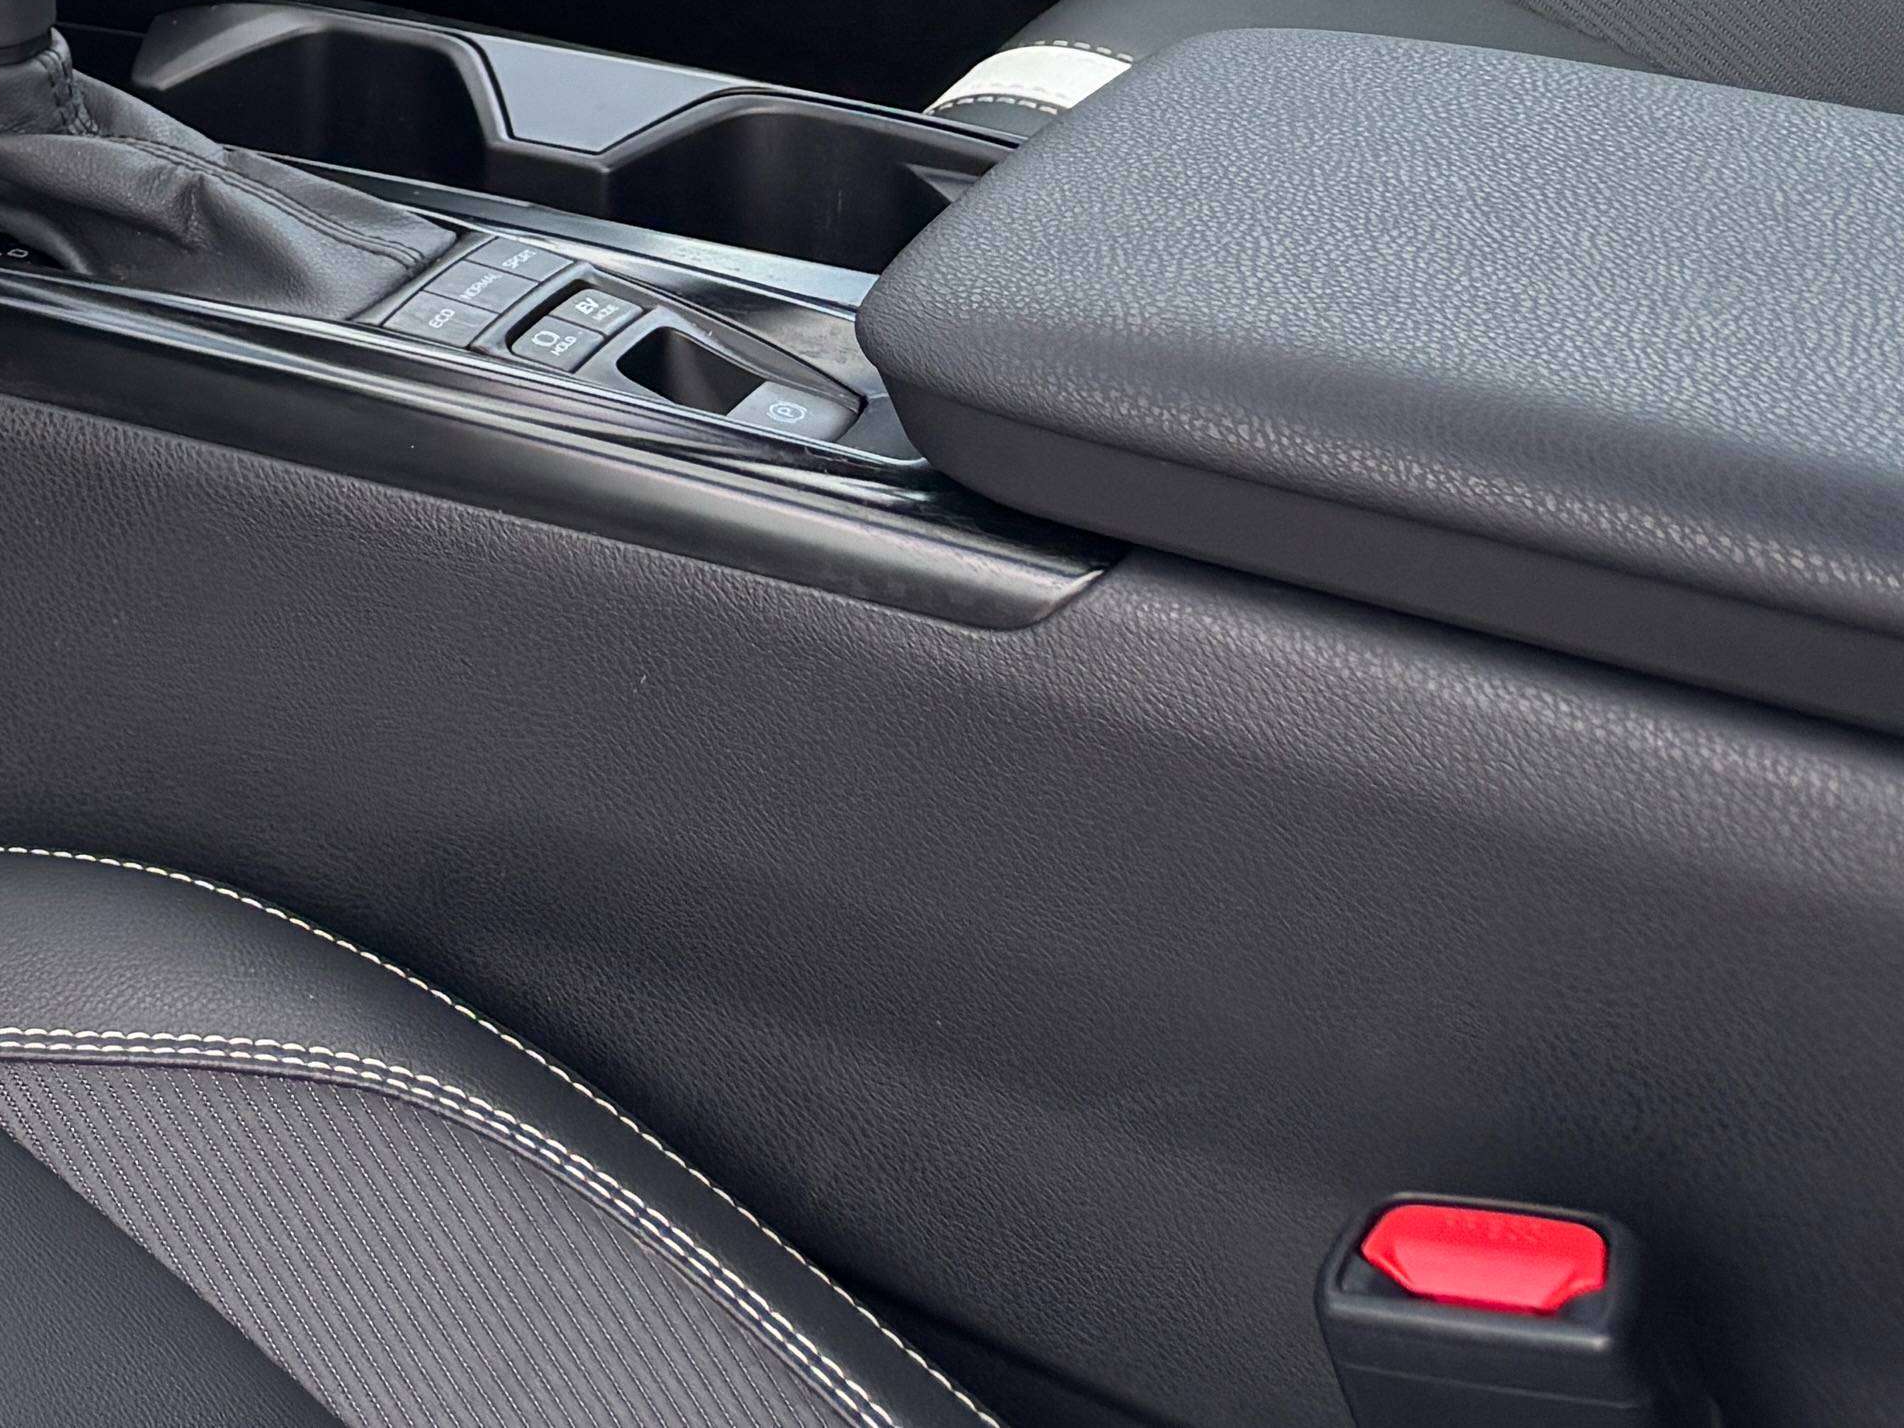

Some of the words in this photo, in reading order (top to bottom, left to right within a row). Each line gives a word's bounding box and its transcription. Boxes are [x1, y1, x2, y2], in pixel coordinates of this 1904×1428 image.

[7, 248, 29, 259] D
[501, 248, 538, 270] SPORT
[460, 272, 503, 300] NORMAL
[575, 297, 599, 315] EV
[593, 303, 620, 321] MODE
[428, 308, 456, 329] ECO
[550, 335, 578, 356] HOLD
